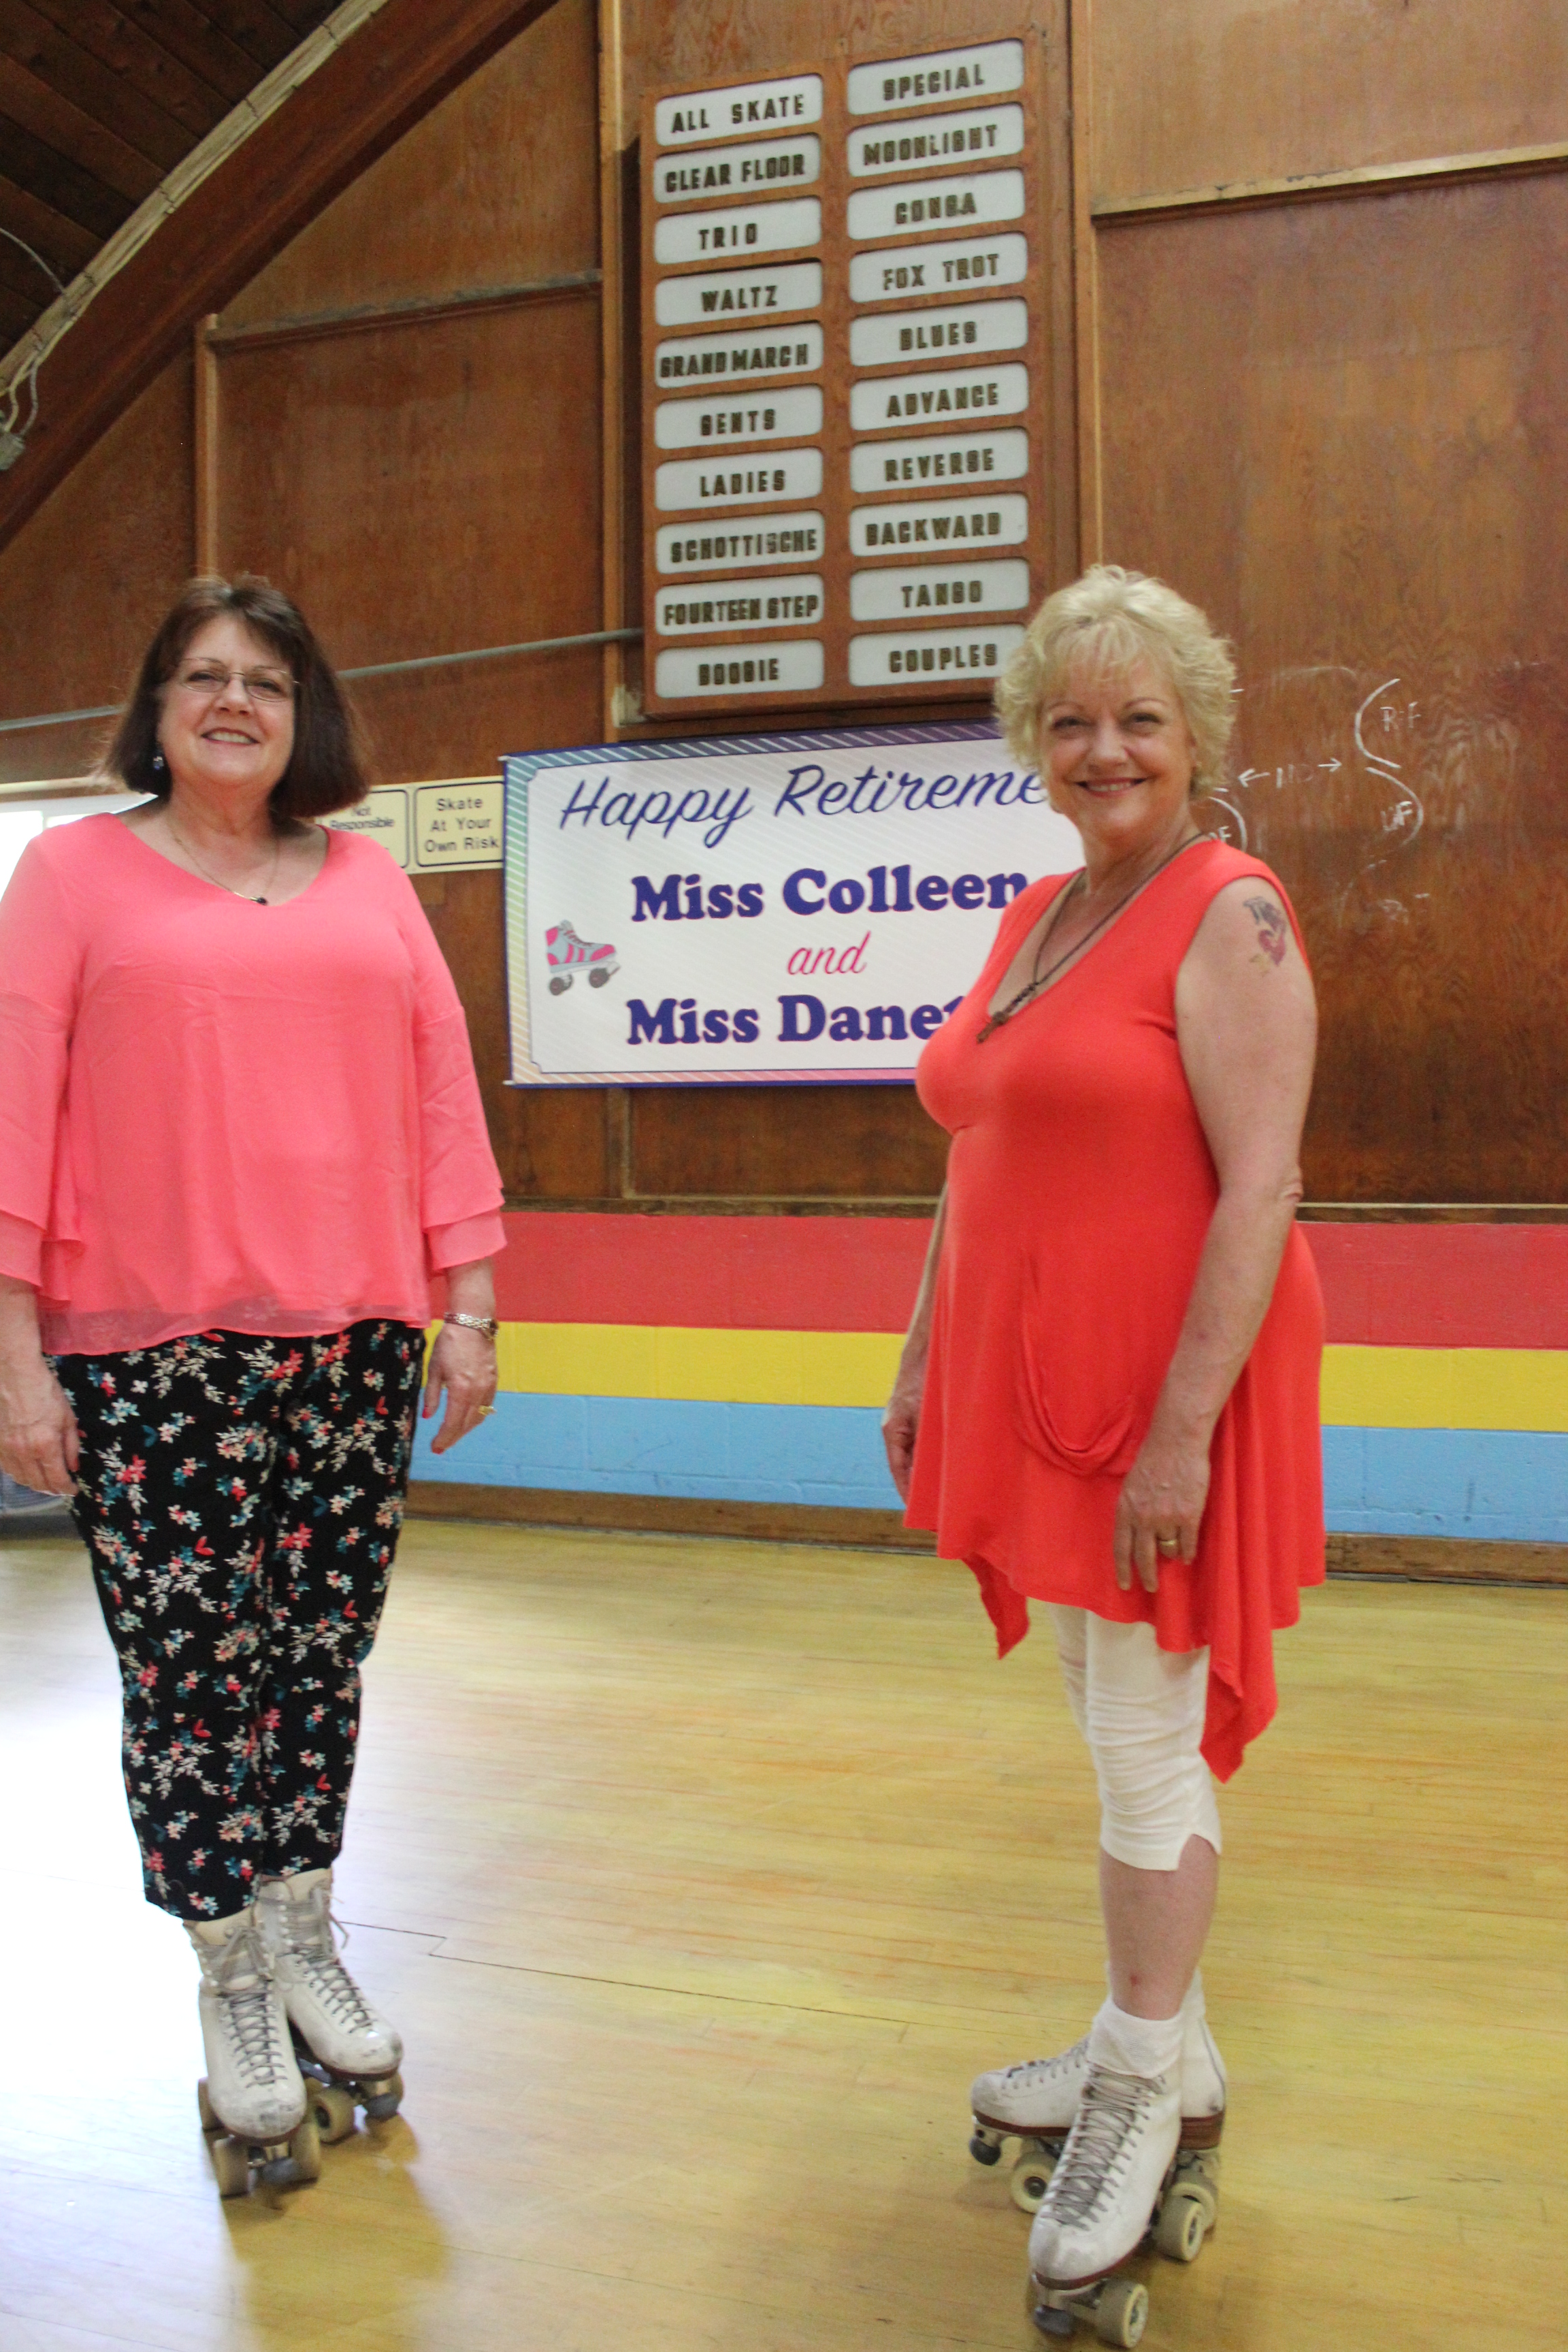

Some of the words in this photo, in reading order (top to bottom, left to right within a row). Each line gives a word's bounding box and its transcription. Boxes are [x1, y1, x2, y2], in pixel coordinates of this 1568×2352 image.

[883, 64, 985, 101] SPECIAL
[672, 109, 710, 133] ALL
[732, 94, 805, 124] SKATE
[862, 125, 998, 166] MOONLIGHT
[665, 163, 732, 193] CLEAR
[741, 154, 805, 182] FLOOR
[895, 193, 977, 225] CONGA
[699, 223, 758, 250] TRIO
[883, 265, 926, 291] FOX
[943, 254, 1000, 282] TROT
[702, 285, 778, 313] WALTZ
[899, 321, 977, 351] BLUES
[659, 351, 727, 378] GRAND
[732, 344, 808, 372] MARCH
[887, 383, 998, 418] ADVANCE
[700, 409, 776, 436] GENTS
[885, 448, 995, 482] REVERSE
[700, 470, 785, 497] LADIES
[866, 512, 1002, 546] BACKWARD
[671, 529, 817, 564] SCHOTTISCHE
[664, 598, 761, 625] FOURTEEN
[767, 595, 818, 619] STEP
[901, 581, 983, 608] TANGO
[889, 644, 998, 674] COUPLES
[436, 797, 483, 812] Skate
[559, 776, 755, 849] Happy
[431, 819, 446, 832] At
[456, 817, 491, 831] Your
[425, 839, 457, 853] Own
[464, 836, 500, 850] Risk
[630, 873, 764, 921] Miss
[782, 864, 1028, 915] Colleen
[787, 930, 872, 975] and
[626, 998, 760, 1045] Miss
